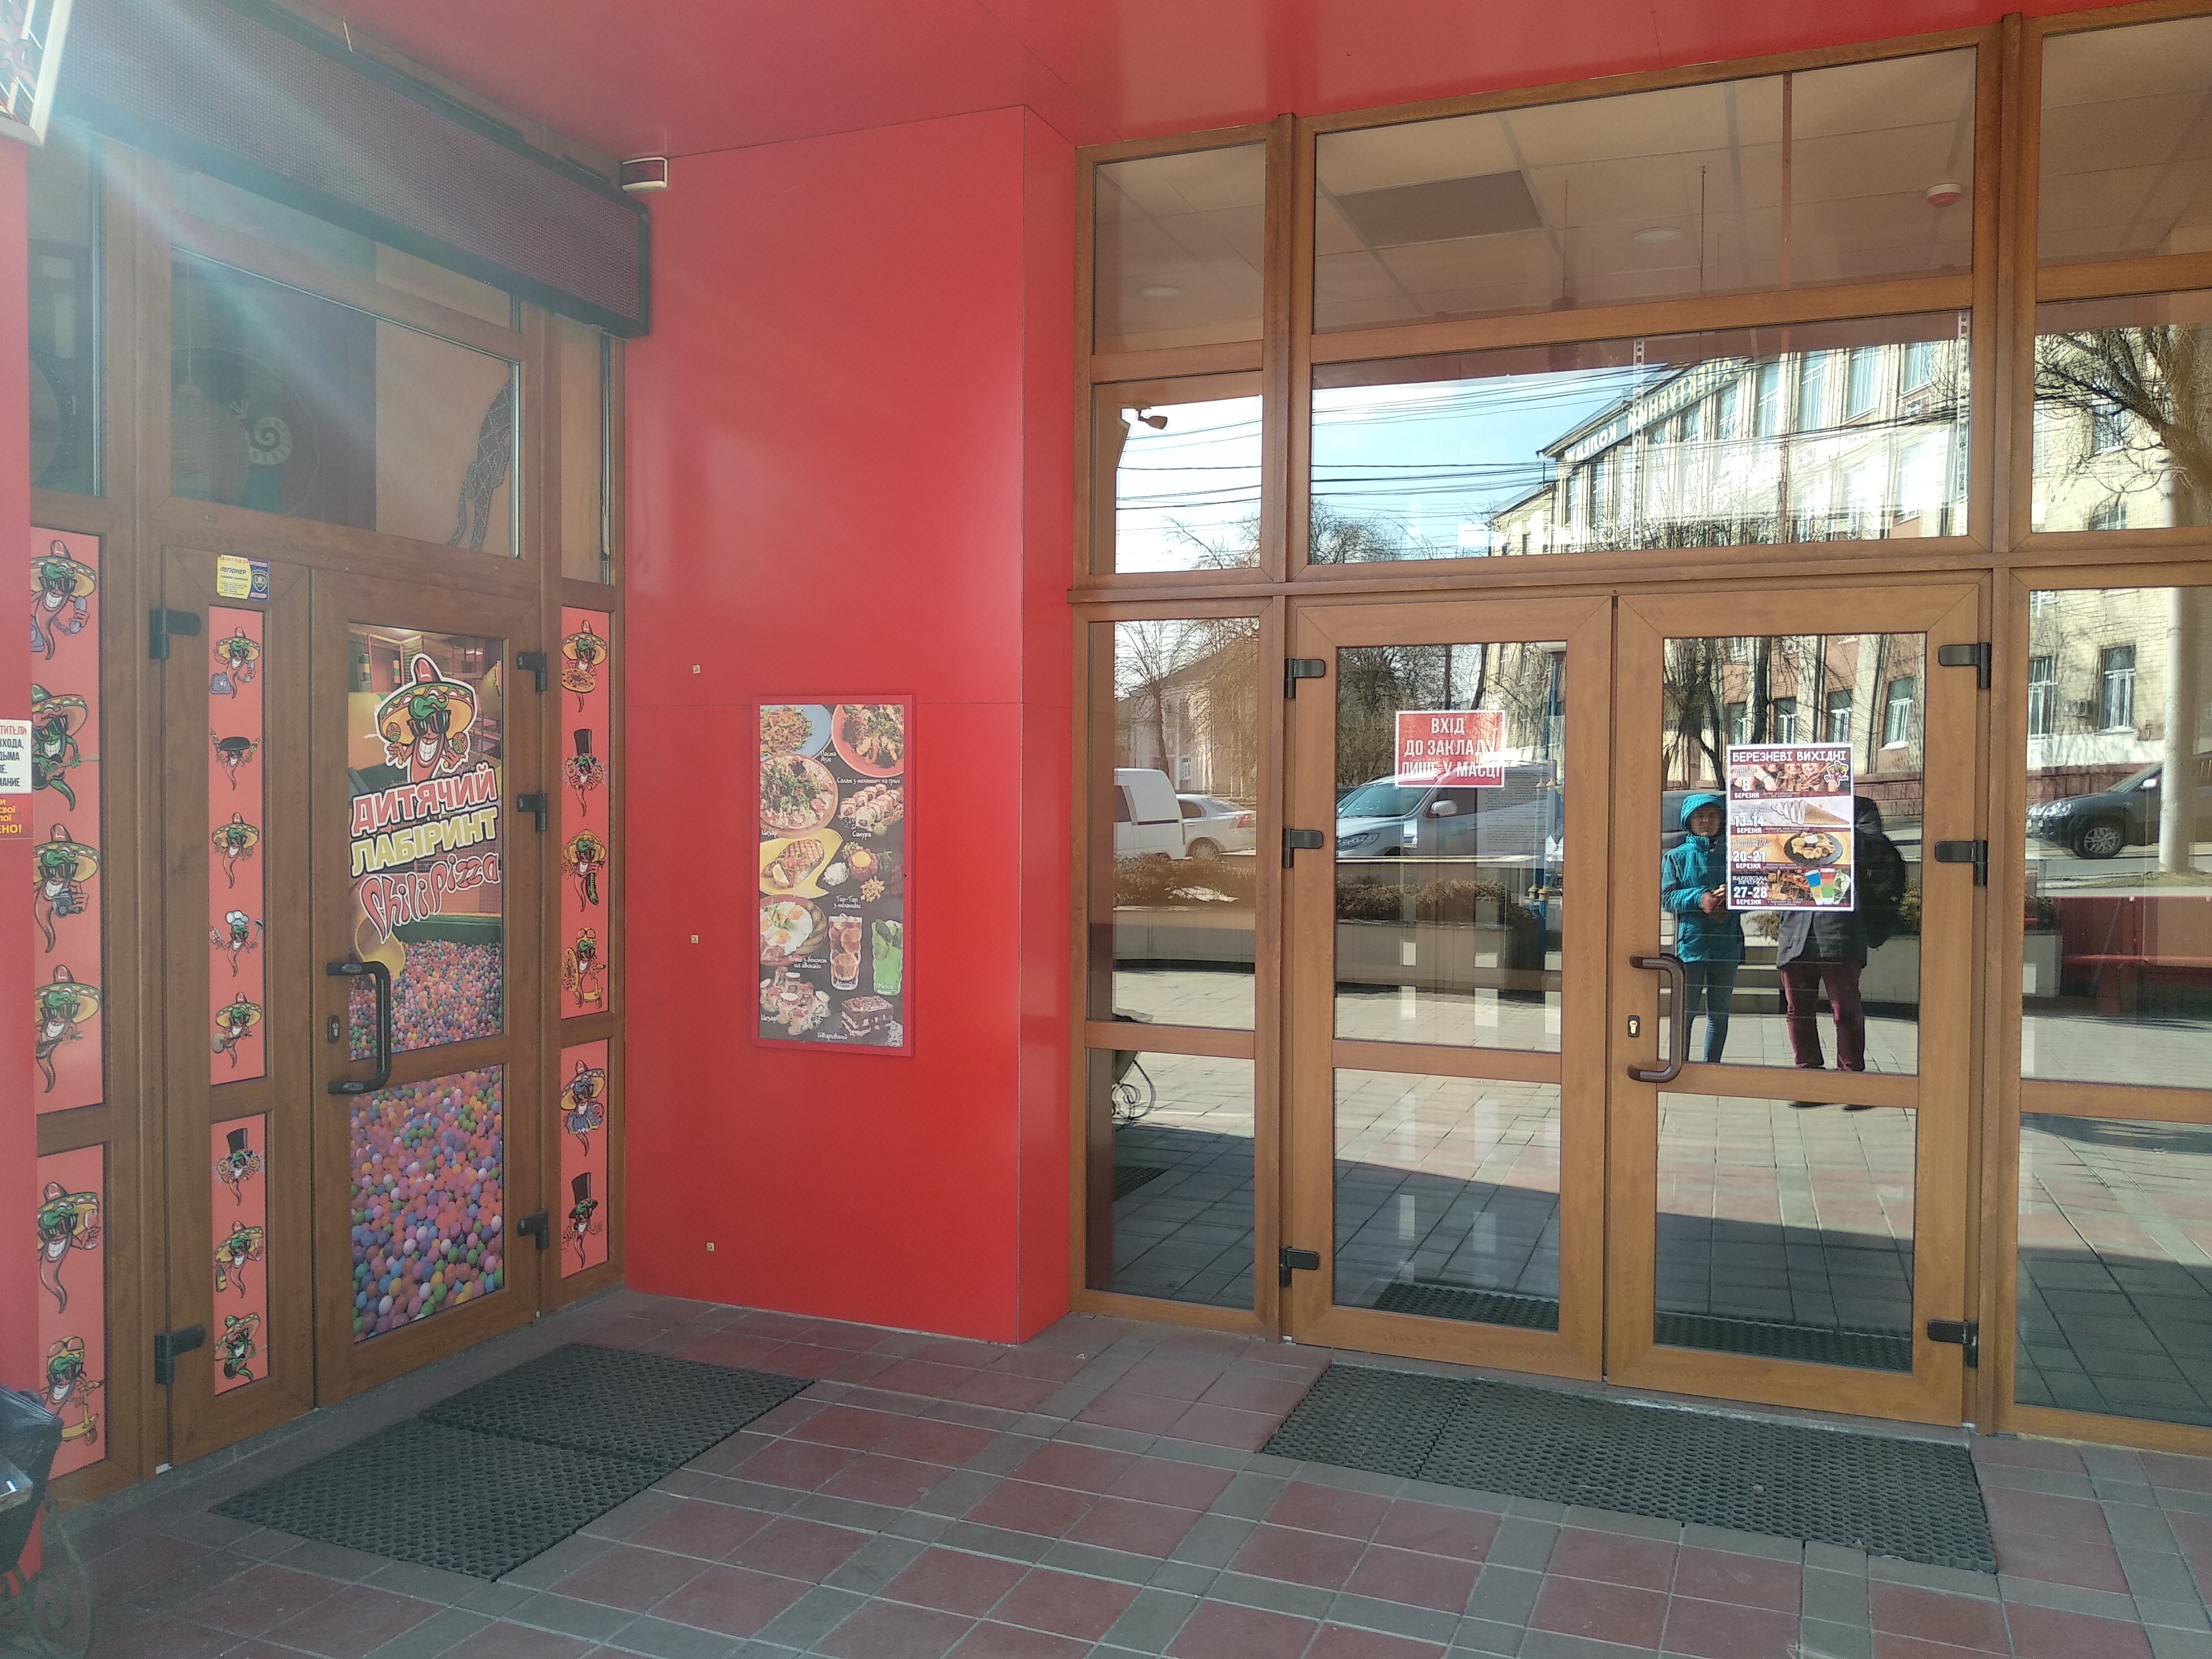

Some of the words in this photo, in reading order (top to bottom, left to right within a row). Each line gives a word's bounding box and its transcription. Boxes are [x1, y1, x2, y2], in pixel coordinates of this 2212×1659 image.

[1431, 717, 1465, 735] ВХІД
[1404, 739, 1423, 757] ДО
[1427, 739, 1495, 757] ЗАКЛАДУ
[820, 755, 832, 764] Азія
[1732, 751, 1793, 763] БЕРЕЗНЕВІ
[1796, 750, 1846, 763] ВИХІДНІ
[1401, 761, 1438, 778] ЛИШЕ
[1442, 761, 1453, 778] У
[1457, 761, 1500, 779] МАСЦІ
[1742, 778, 1750, 791] 8
[351, 763, 497, 836] ДИТЯЧИЙ
[1733, 815, 1765, 827] 13-14
[761, 829, 778, 838] Цезар
[852, 830, 872, 840] Сакура
[351, 807, 497, 875] ЛАБІРИНТ
[1733, 851, 1766, 862] 20-21
[1733, 886, 1768, 899] 27-28
[835, 895, 858, 905] Тар-Тар
[760, 1014, 778, 1024] Цезар
